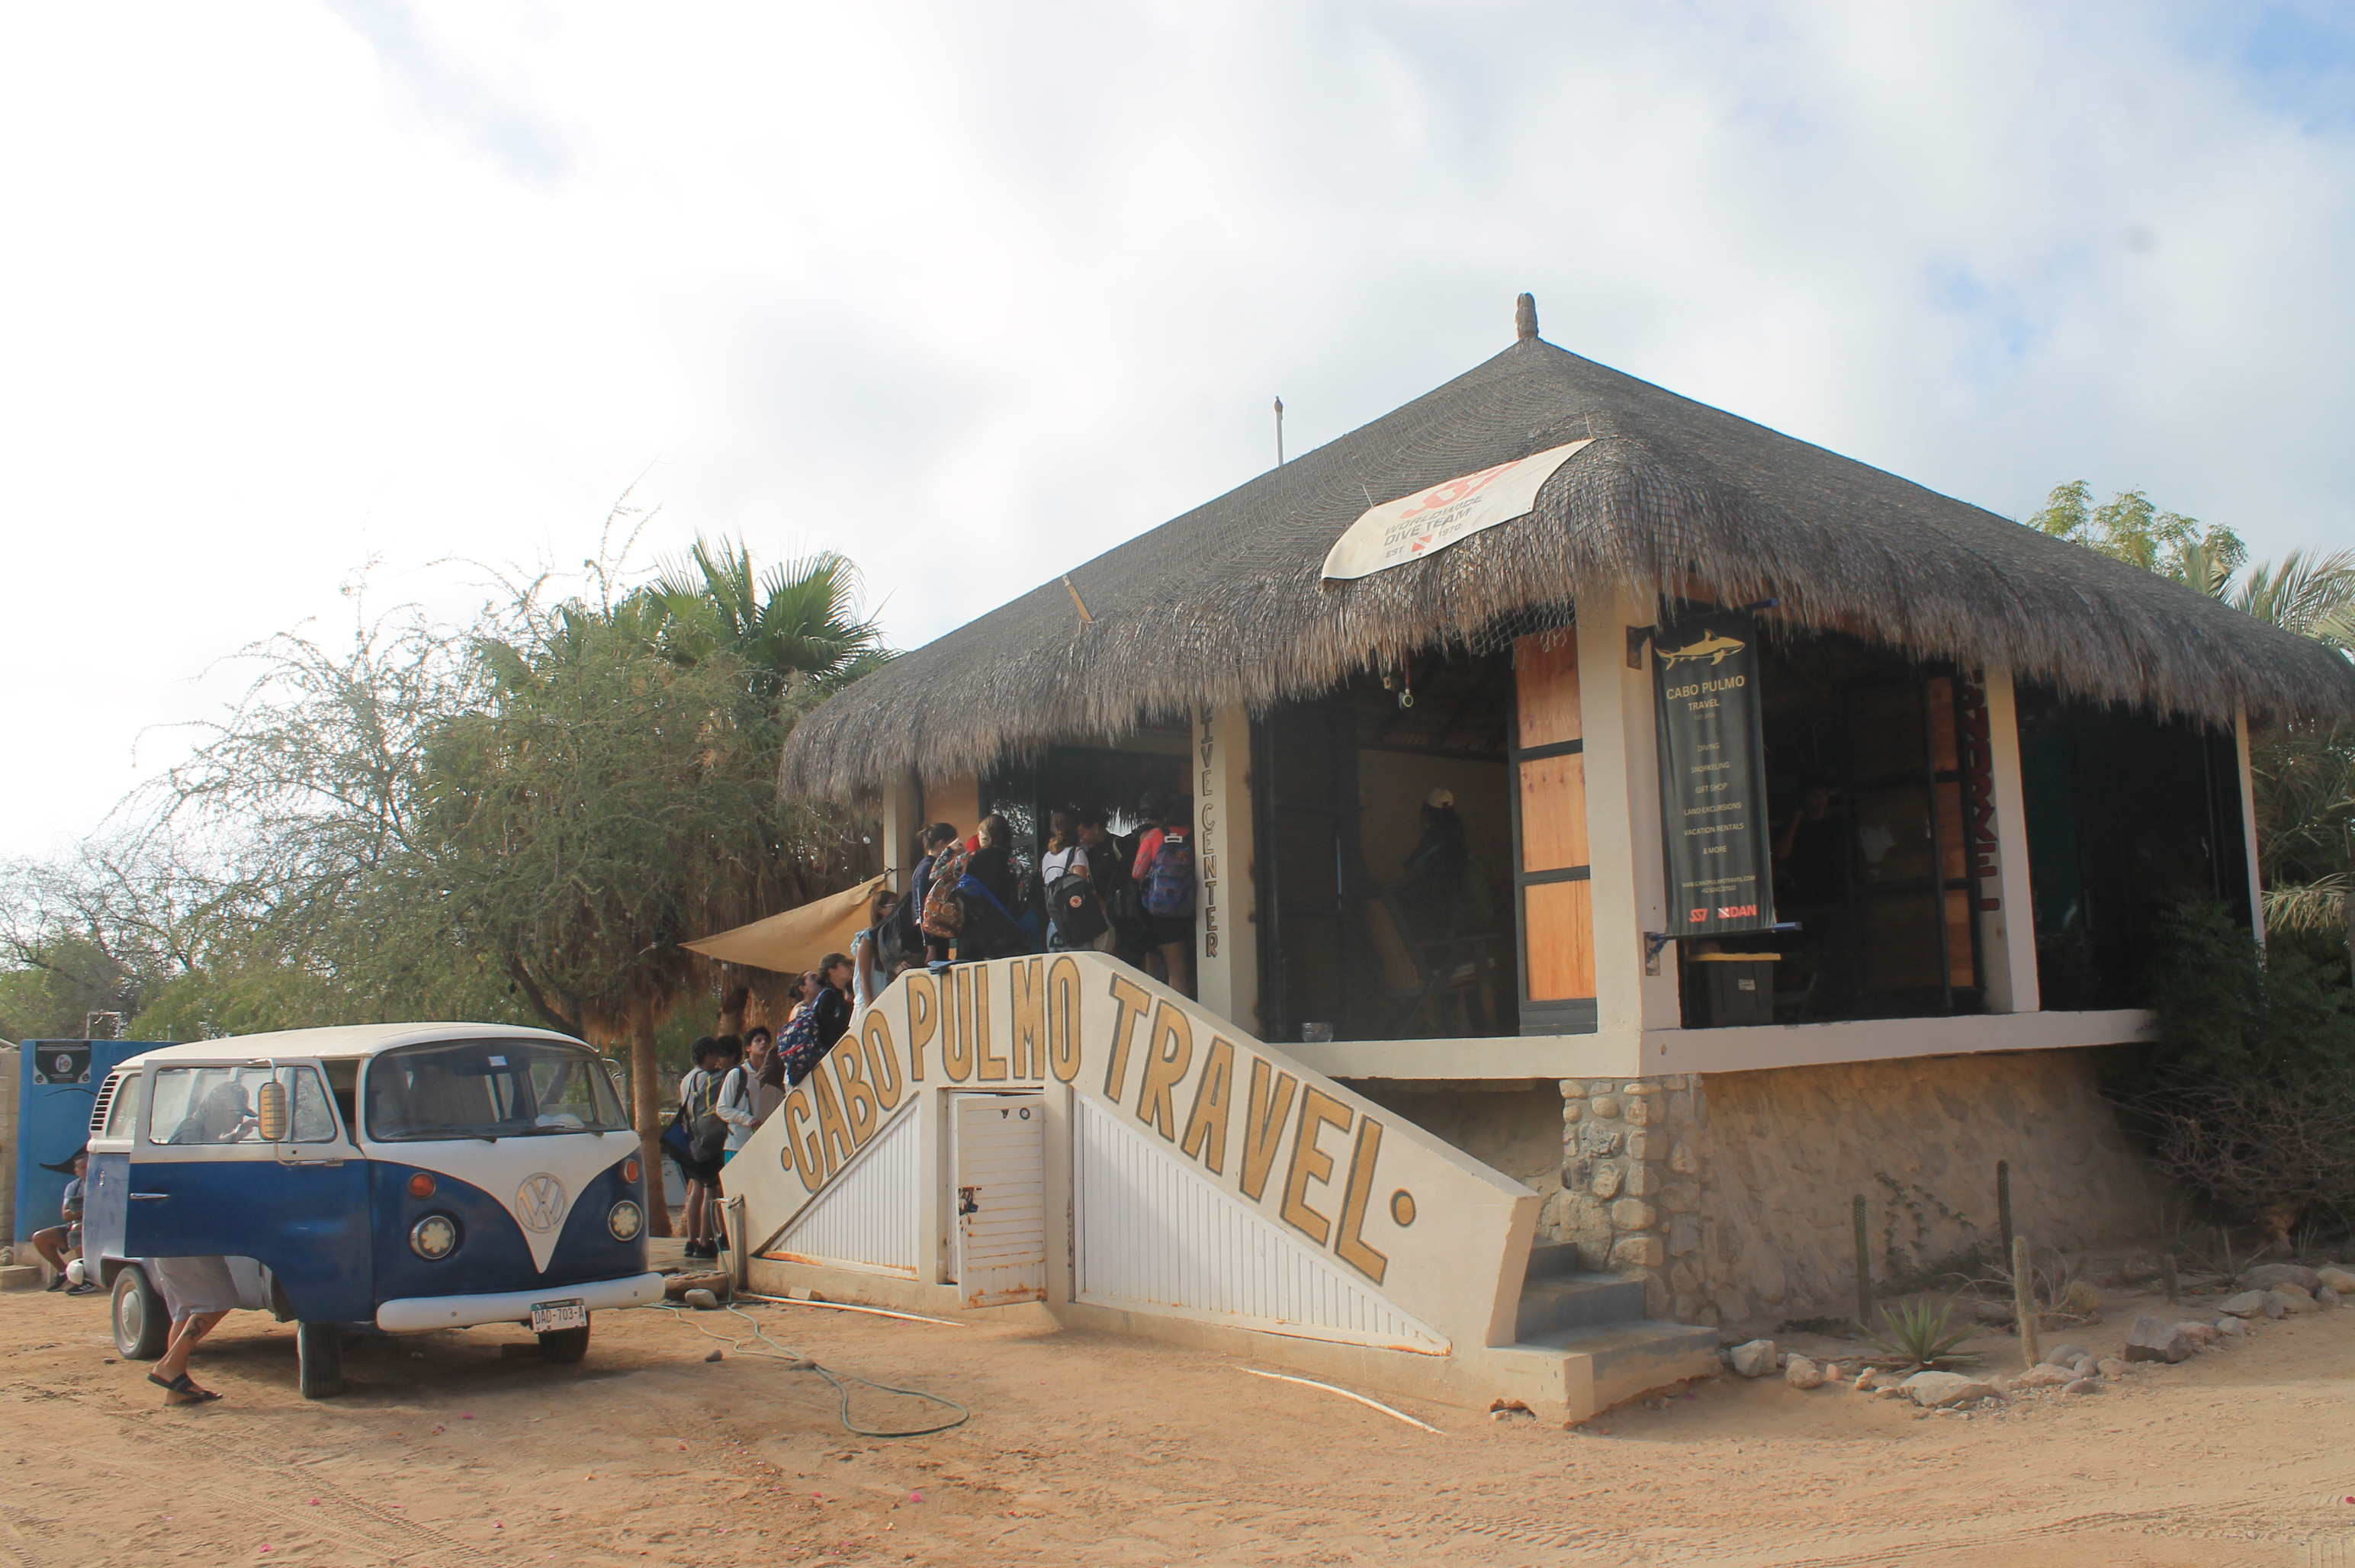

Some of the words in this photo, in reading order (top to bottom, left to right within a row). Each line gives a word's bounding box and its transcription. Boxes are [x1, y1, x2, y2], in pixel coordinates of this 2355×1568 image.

[1385, 495, 1483, 535] WORLDWIDE
[1383, 524, 1421, 547] DIVE
[1425, 507, 1472, 532] TEAM
[1385, 545, 1405, 558] EST.
[1438, 523, 1462, 538] 1970
[1666, 684, 1699, 700] CABO
[1701, 675, 1746, 694] PULMO
[1688, 698, 1720, 711] TRAVEL
[1698, 742, 1720, 752] DIVING
[1690, 762, 1730, 773] SNORKELING
[1695, 785, 1708, 794] GIFT
[1710, 782, 1727, 792] SHOP
[1684, 807, 1701, 816] LAND
[1701, 802, 1742, 814] EXCURSIONS
[1683, 827, 1715, 836] VACATION
[1716, 822, 1745, 832] RENTALS
[1708, 845, 1727, 853] MORE
[1201, 802, 1219, 958] CENTER
[1689, 908, 1708, 922] SSI
[1730, 904, 1757, 917] DAN
[785, 1008, 902, 1193] CABO
[906, 956, 1081, 1084] PULMO
[1103, 972, 1388, 1285] TRAVEL
[517, 1174, 567, 1231] VW
[535, 1306, 584, 1324] DAD-703-A
